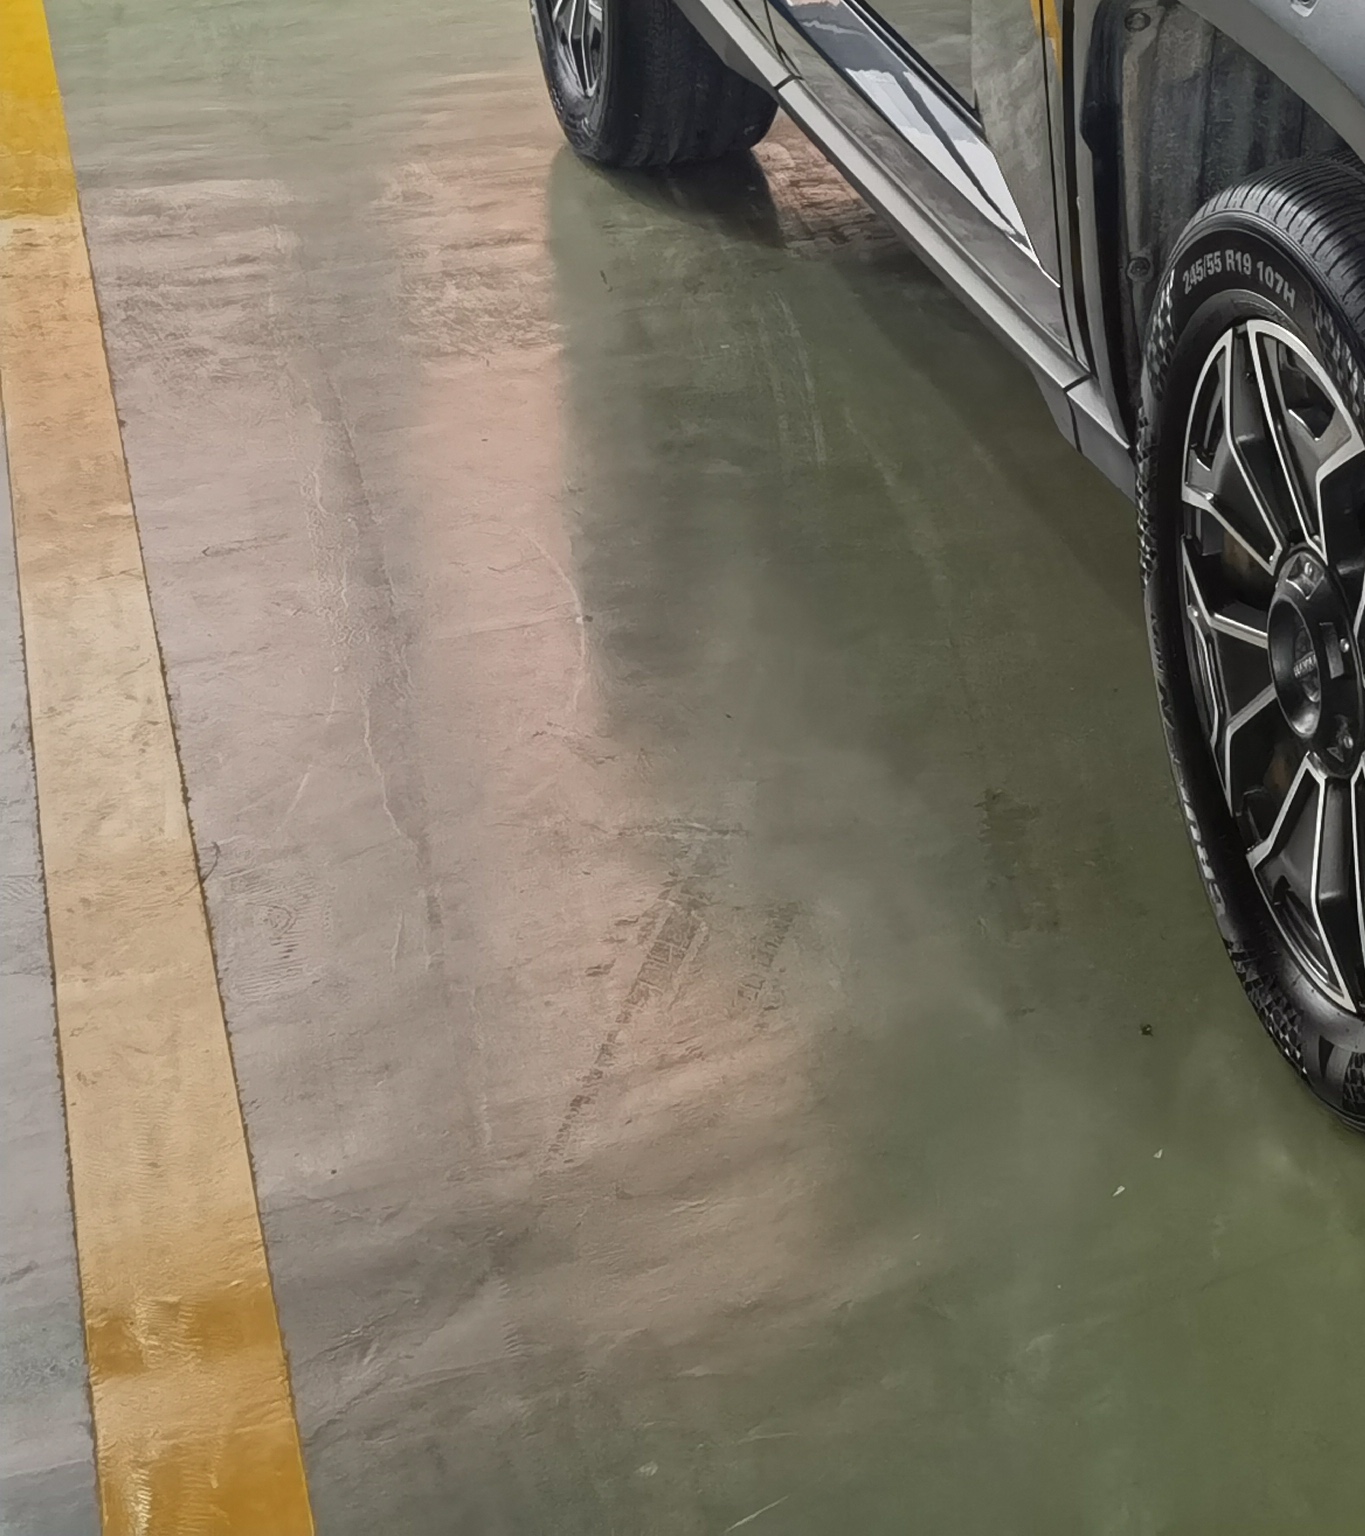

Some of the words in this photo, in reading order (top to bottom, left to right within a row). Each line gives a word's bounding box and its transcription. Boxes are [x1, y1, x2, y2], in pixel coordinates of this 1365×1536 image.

[1182, 250, 1223, 295] 245/55
[1225, 249, 1252, 275] R19
[1257, 261, 1296, 309] 107H
